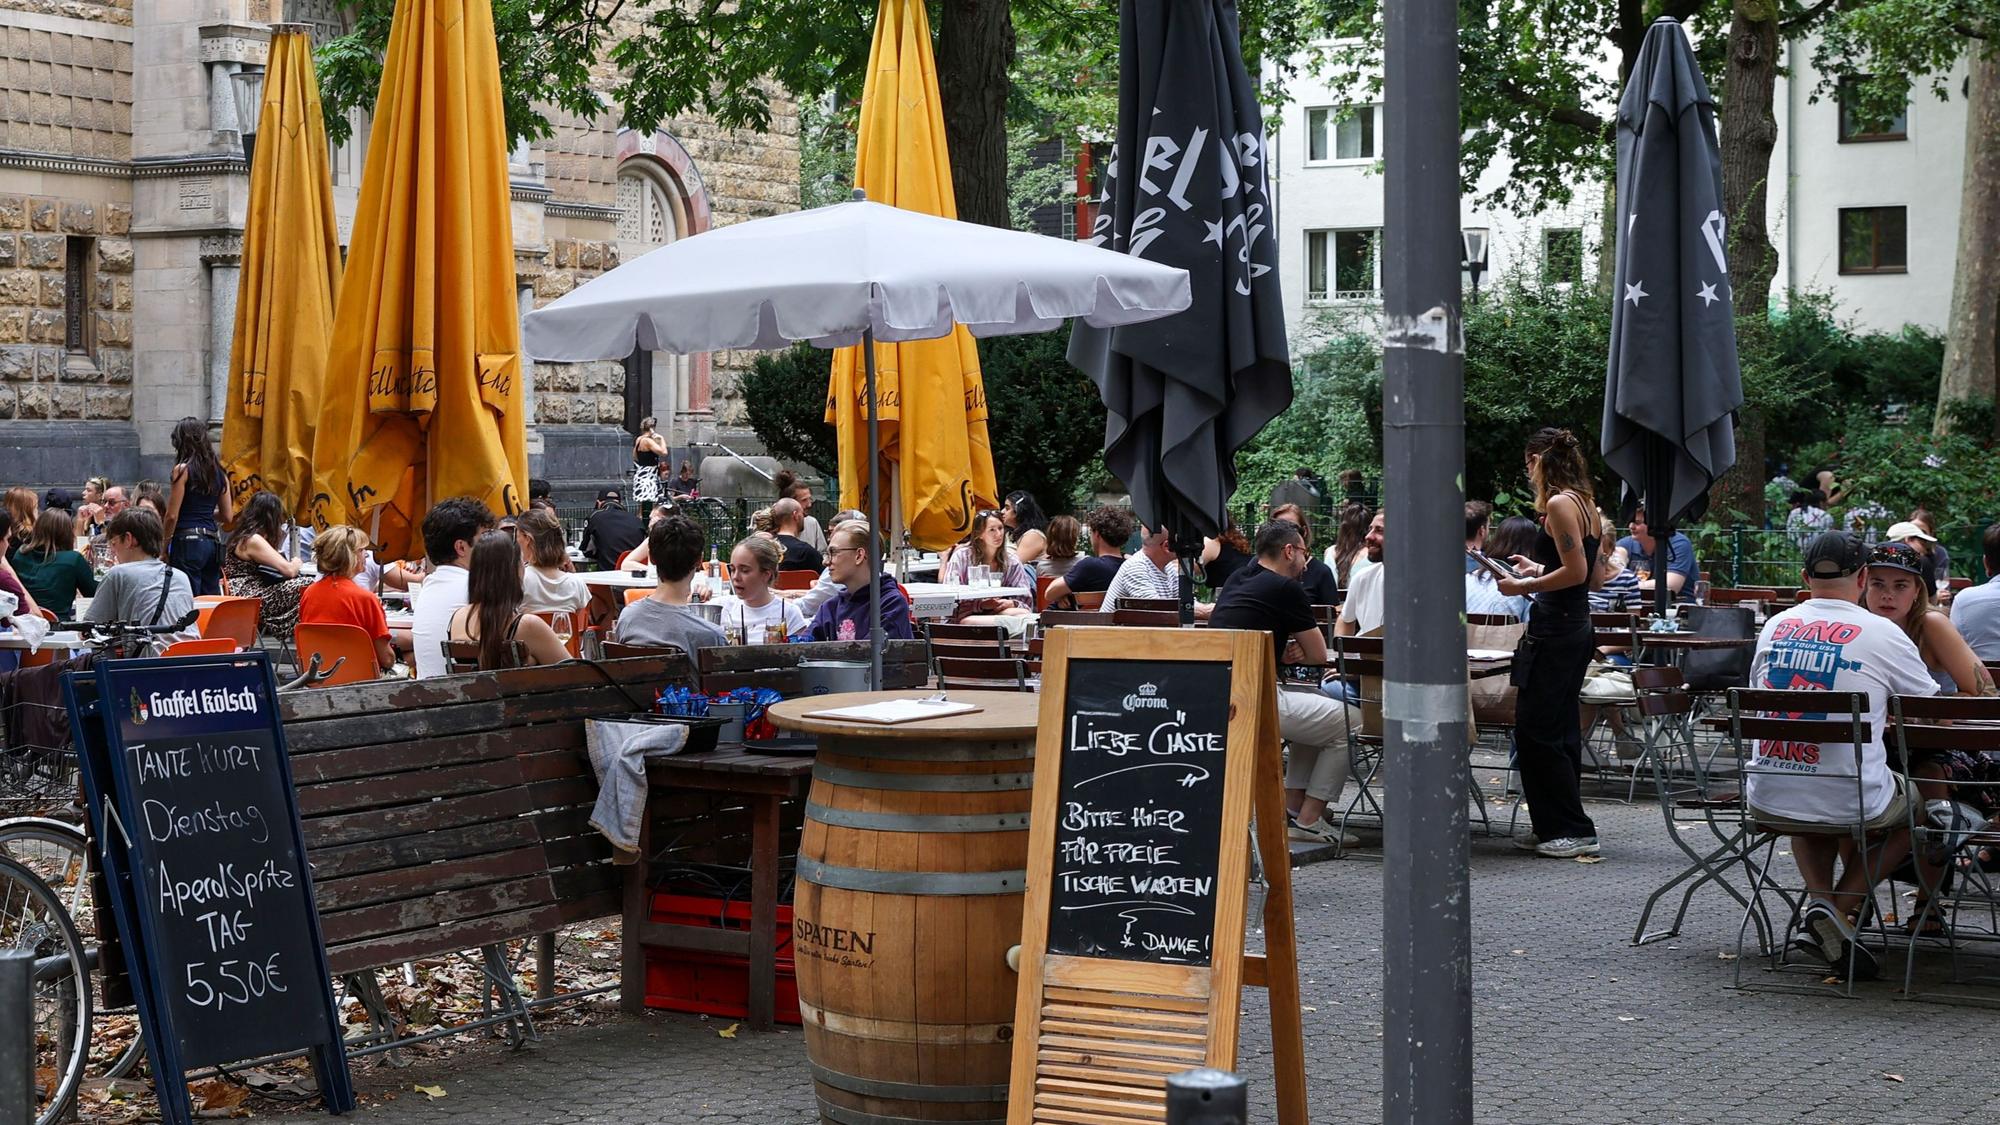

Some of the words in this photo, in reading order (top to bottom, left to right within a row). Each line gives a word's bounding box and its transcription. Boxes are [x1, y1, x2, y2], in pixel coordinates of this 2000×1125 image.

[1771, 619, 1862, 644] DYNO
[1794, 641, 1817, 650] TOUR
[1818, 644, 1836, 652] USA
[150, 688, 202, 719] Gaffel
[200, 685, 258, 714] Kölsch
[1122, 692, 1169, 712] Corona
[1148, 709, 1225, 756] GÄSTE
[126, 744, 192, 785] TANTE
[196, 742, 261, 774] KURT
[1759, 740, 1820, 765] VANS
[1773, 761, 1818, 773] LEGENDS
[143, 799, 269, 844] Dienstag
[1061, 836, 1102, 865] FÜR
[1130, 875, 1213, 898] WARTEN
[196, 910, 253, 953] TAG
[797, 918, 876, 955] SPATEN
[186, 952, 288, 1012] 5,50€
